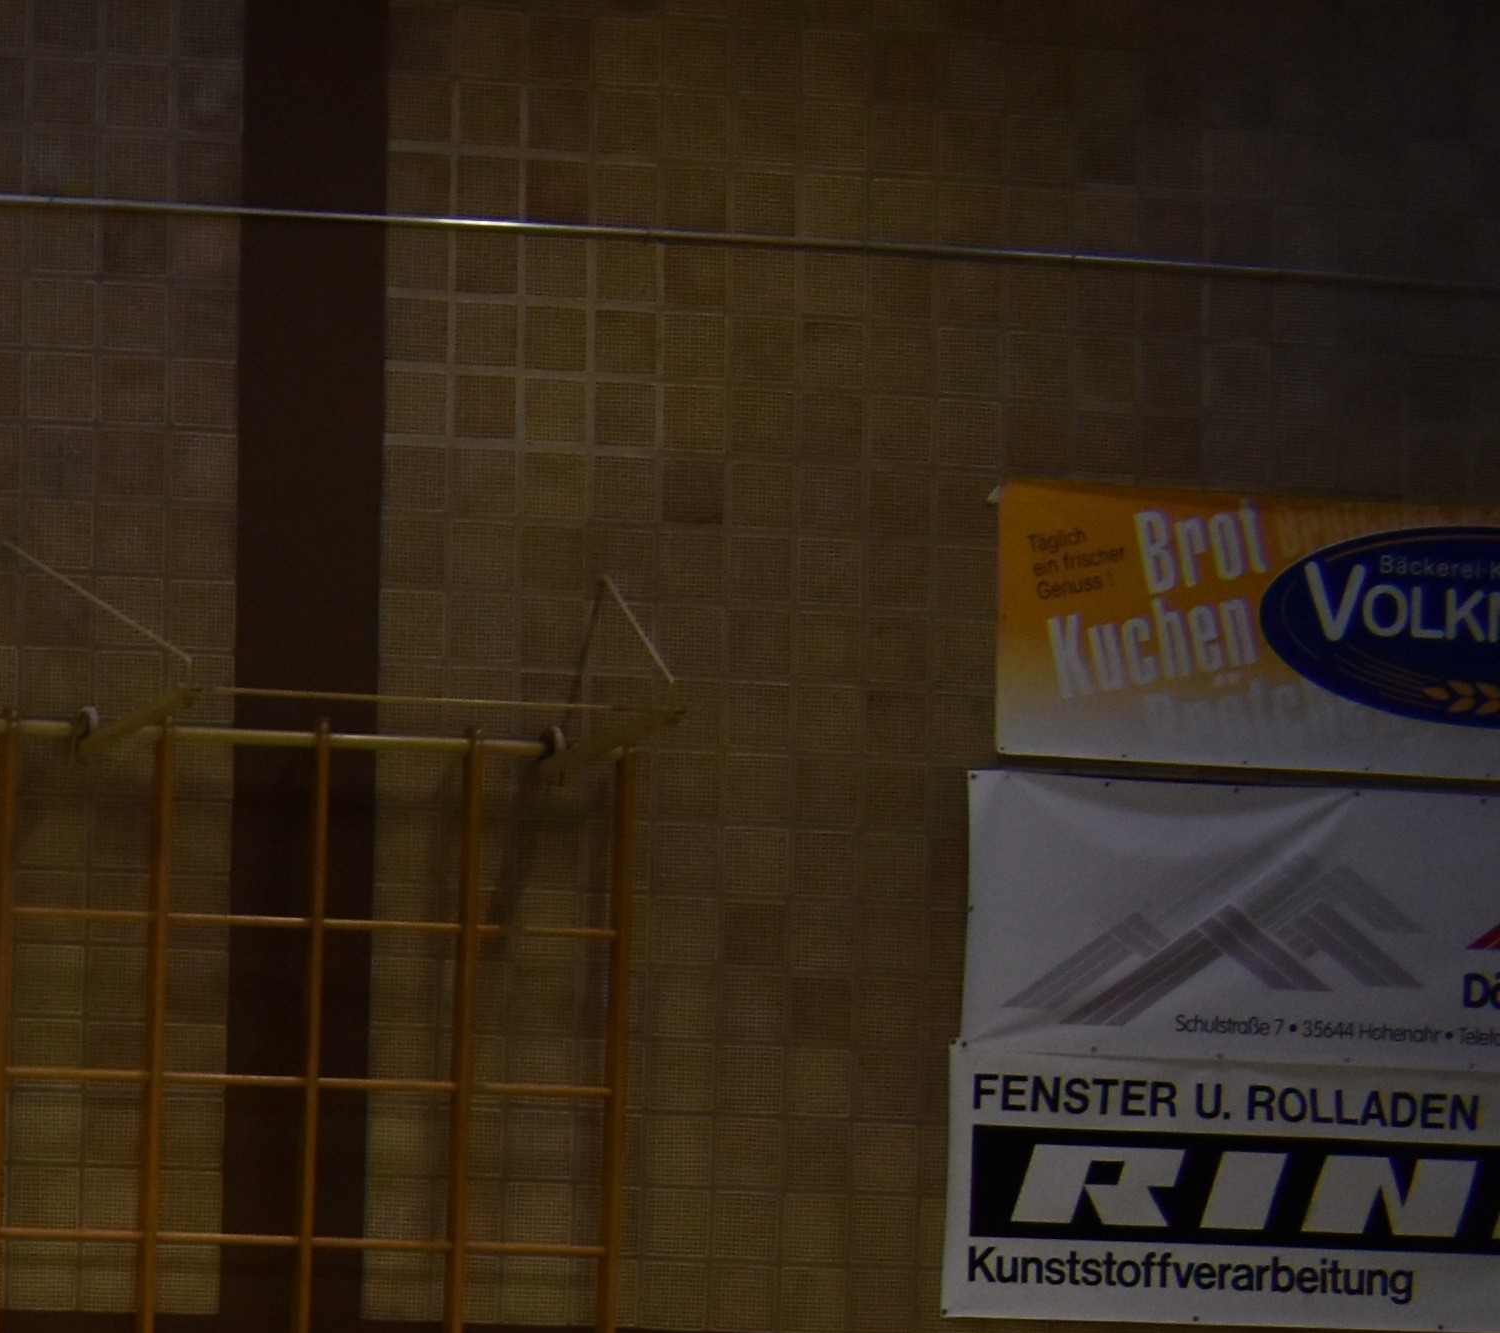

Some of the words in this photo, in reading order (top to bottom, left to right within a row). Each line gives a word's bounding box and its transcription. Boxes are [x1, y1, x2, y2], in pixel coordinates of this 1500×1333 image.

[1134, 496, 1271, 595] Brot
[1047, 597, 1261, 699] Kuchen
[1176, 1014, 1270, 1037] Schulstraße
[1302, 1020, 1354, 1039] 35644
[1358, 1022, 1442, 1044] Hohenahr
[972, 1073, 1177, 1117] FENSTER
[1195, 1083, 1231, 1121] U.
[1246, 1086, 1481, 1131] ROLLADEN
[967, 1246, 1415, 1304] Kunststoffverarbeitung
